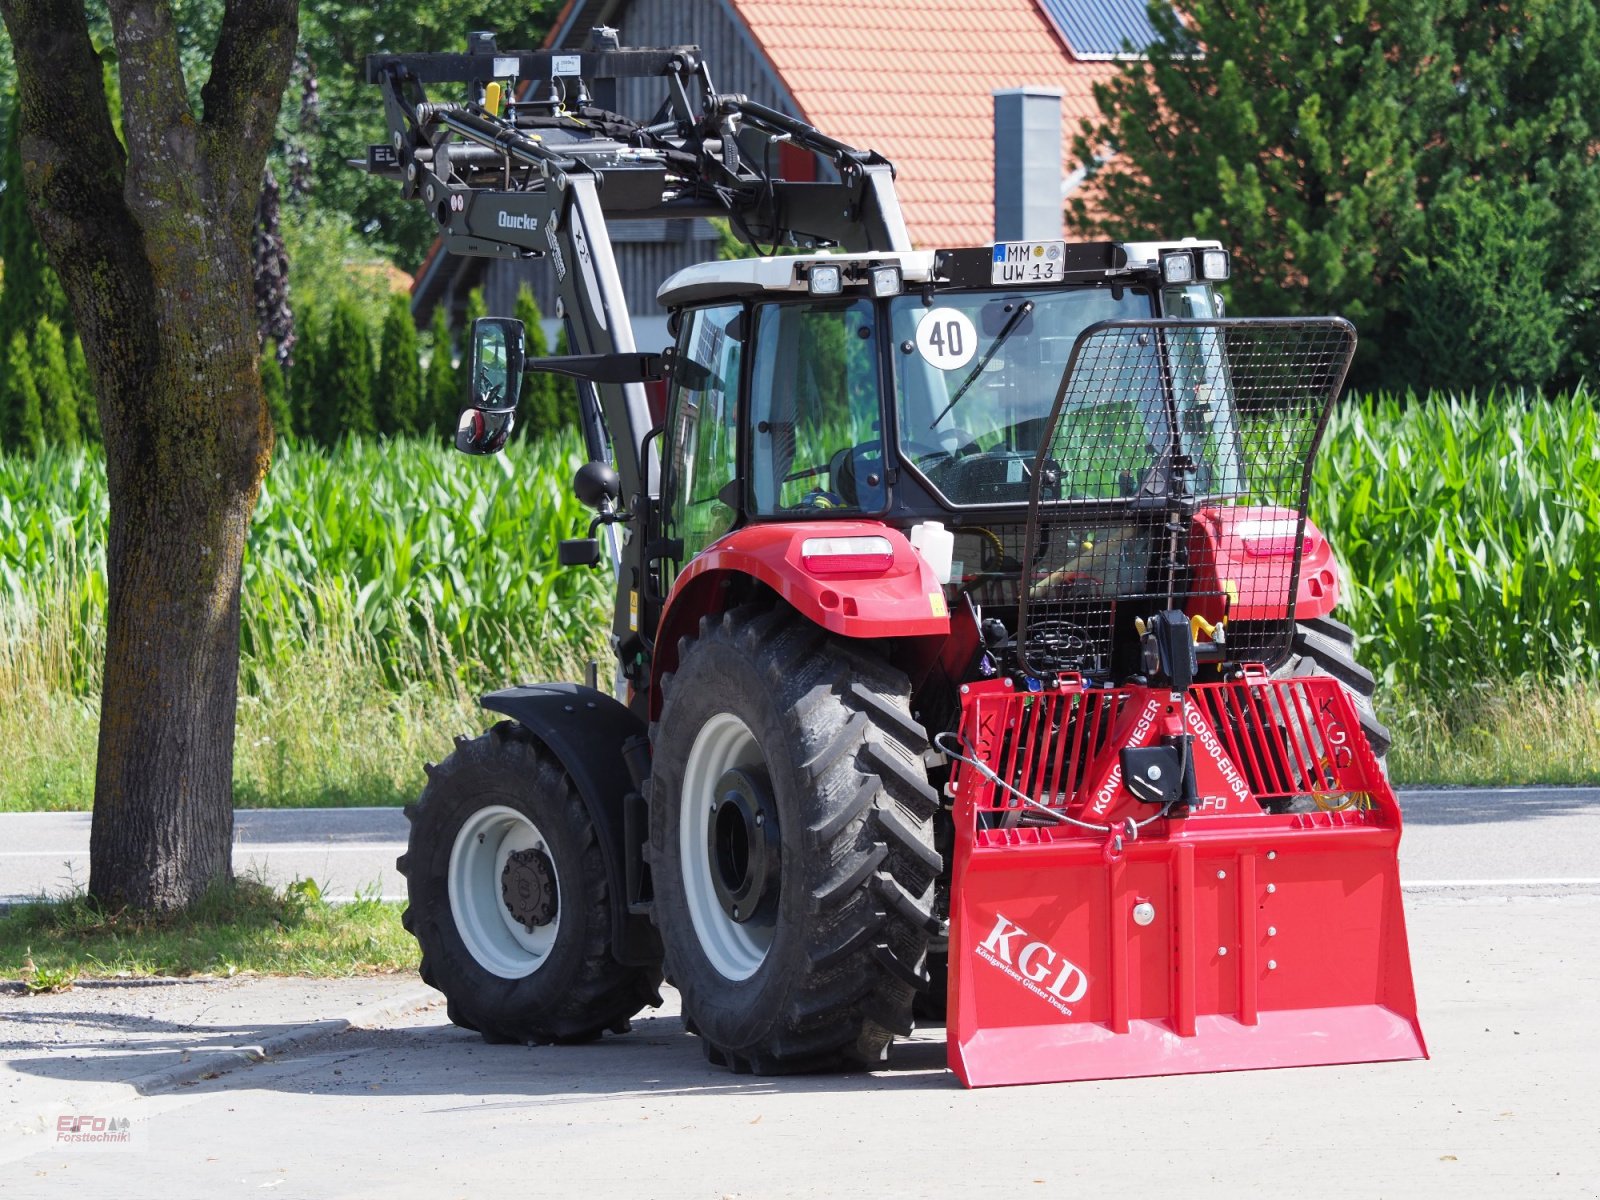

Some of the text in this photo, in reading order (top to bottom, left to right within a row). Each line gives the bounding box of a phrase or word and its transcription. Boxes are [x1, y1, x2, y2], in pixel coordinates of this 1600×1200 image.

[498, 210, 538, 231] Quicke
[1003, 263, 1054, 281] UW 13
[1007, 245, 1031, 262] MM
[929, 321, 964, 357] 40
[1092, 699, 1161, 815] KÖNIGIESER
[1319, 696, 1353, 769] KGD
[974, 946, 1072, 1017] Königswieser Günter Design
[979, 913, 1088, 1003] KGD
